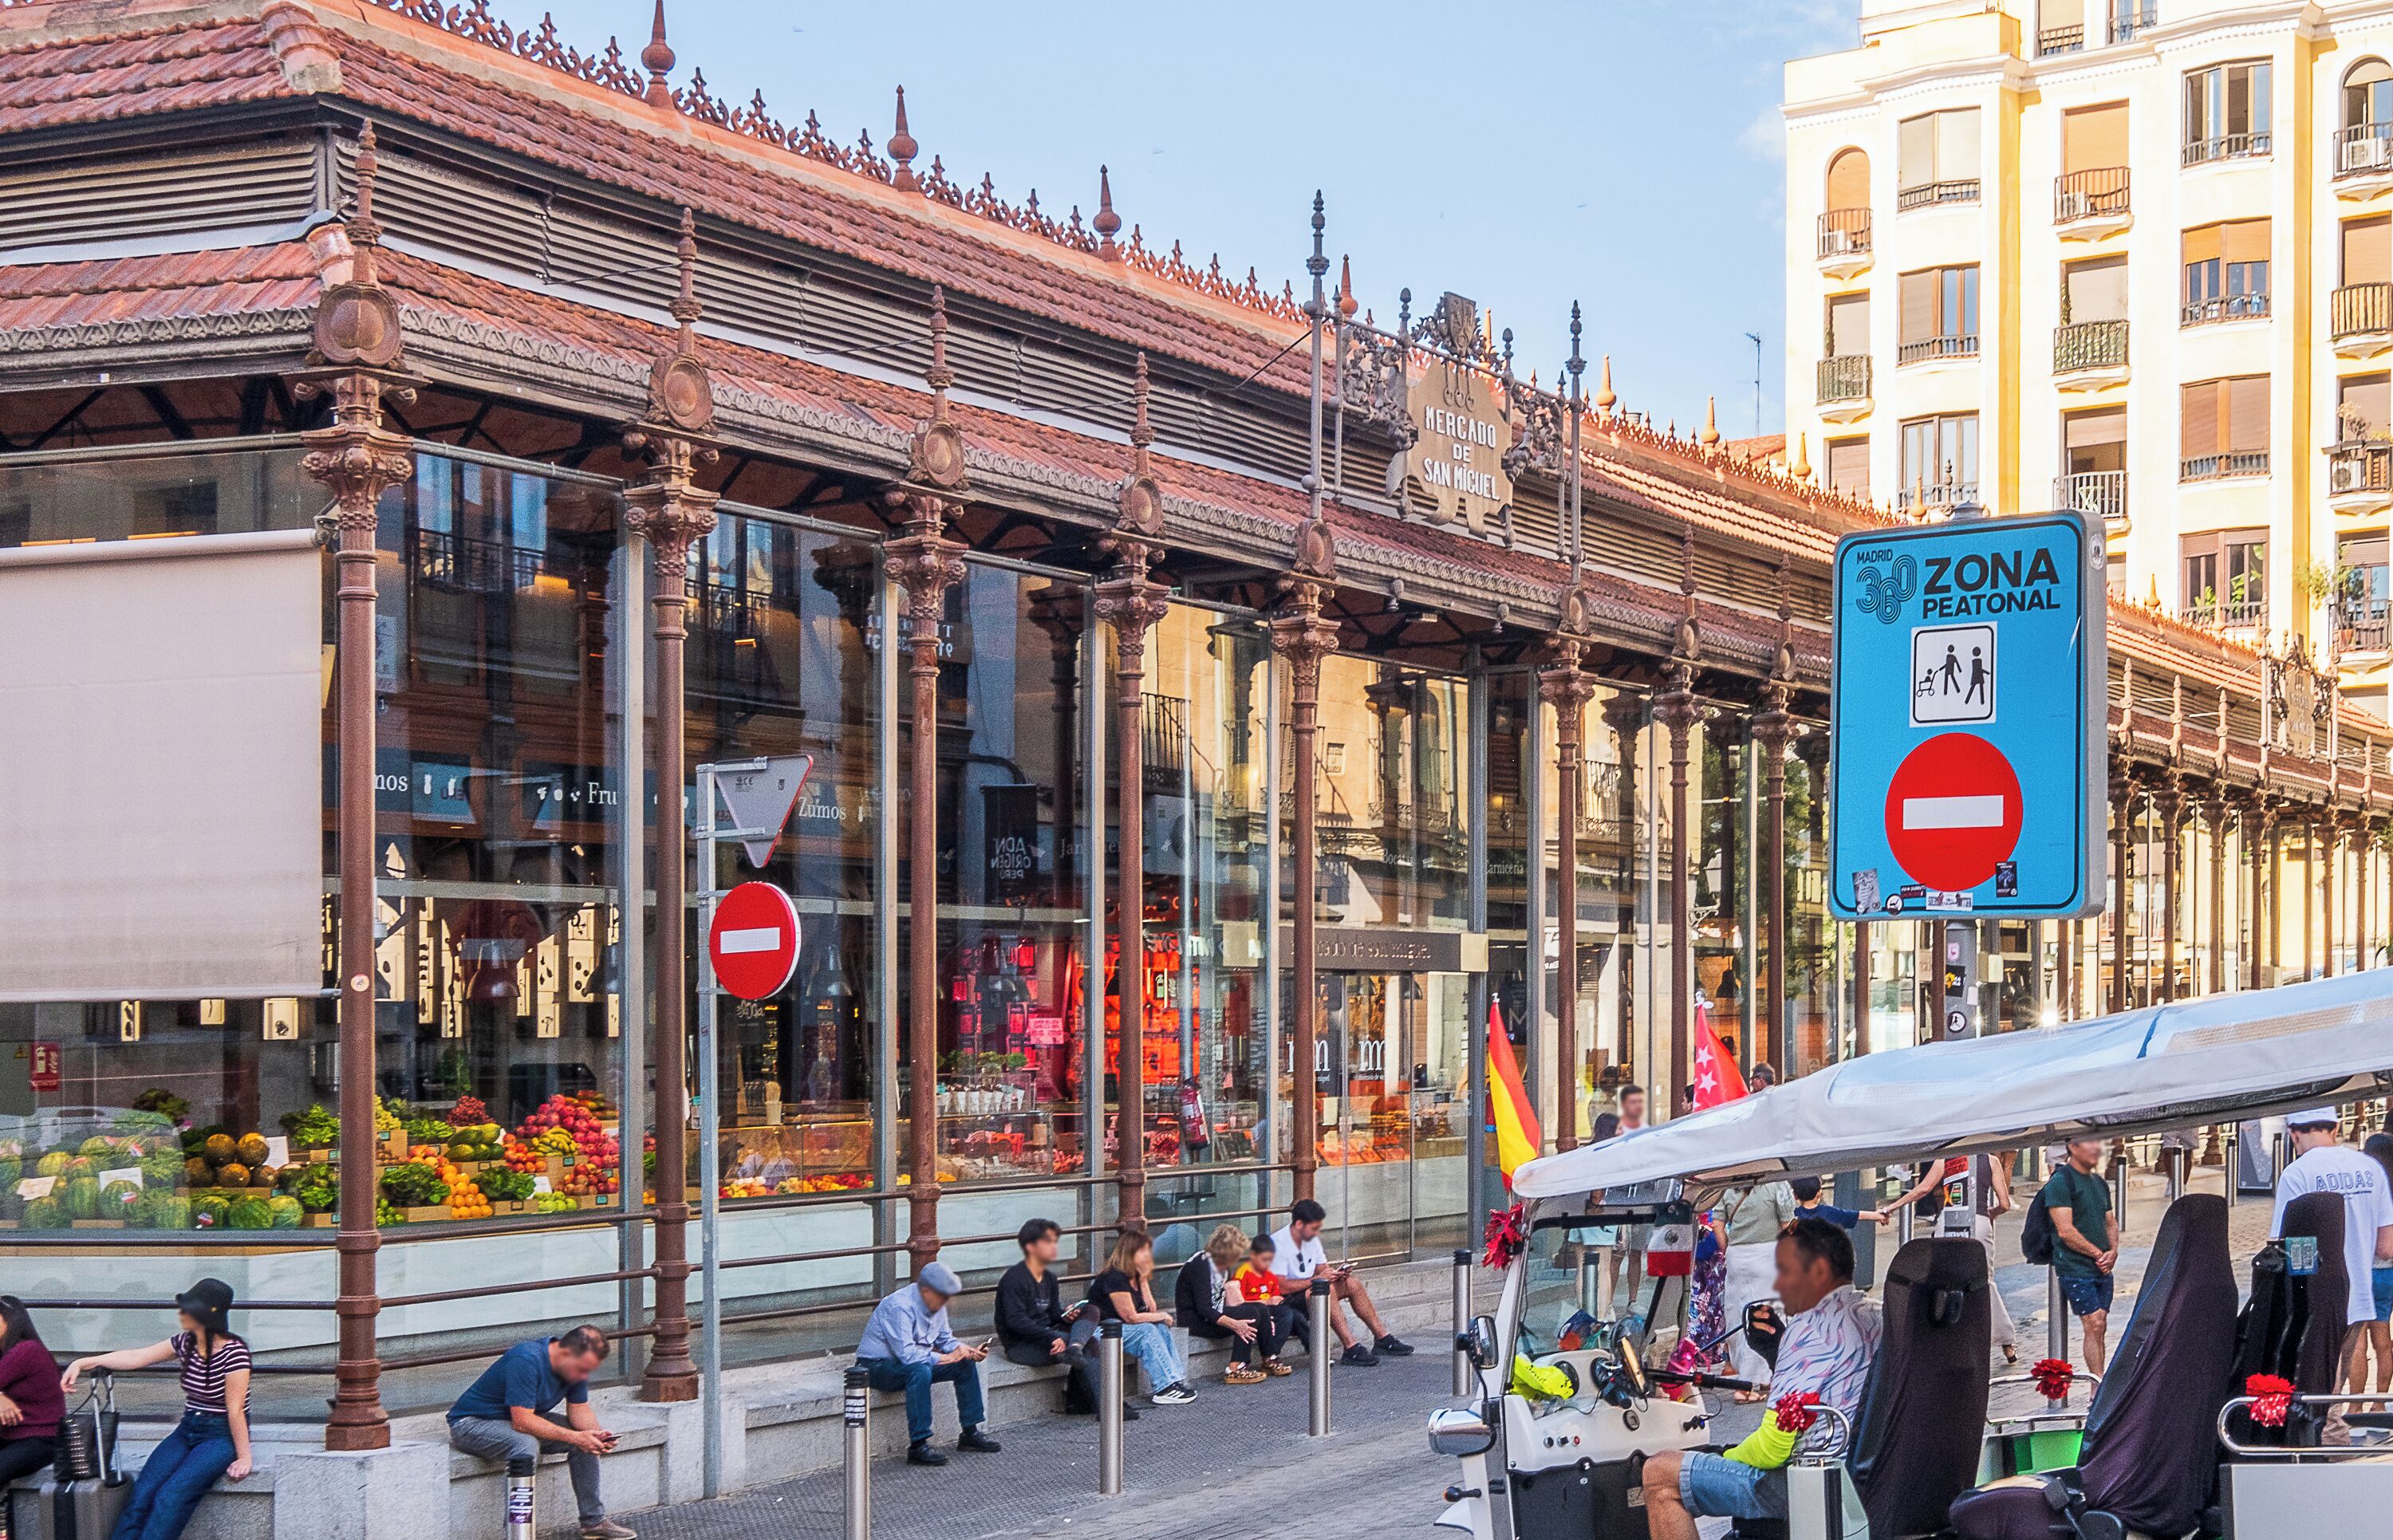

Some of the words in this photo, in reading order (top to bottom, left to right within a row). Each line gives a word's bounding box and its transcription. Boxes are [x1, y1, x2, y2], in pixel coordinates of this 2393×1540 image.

[1425, 405, 1497, 449] MERCADO
[1453, 443, 1472, 463] DE
[1424, 457, 1451, 487] SAN
[1856, 549, 1893, 565] MADRID
[1923, 548, 2060, 596] ZONA
[1855, 554, 1918, 625] 360
[1922, 588, 2061, 620] PEATONAL
[374, 774, 408, 792] mos
[798, 798, 847, 821] Zumos
[1486, 860, 1525, 876] arnicería
[2316, 1171, 2374, 1191] ADIDAS
